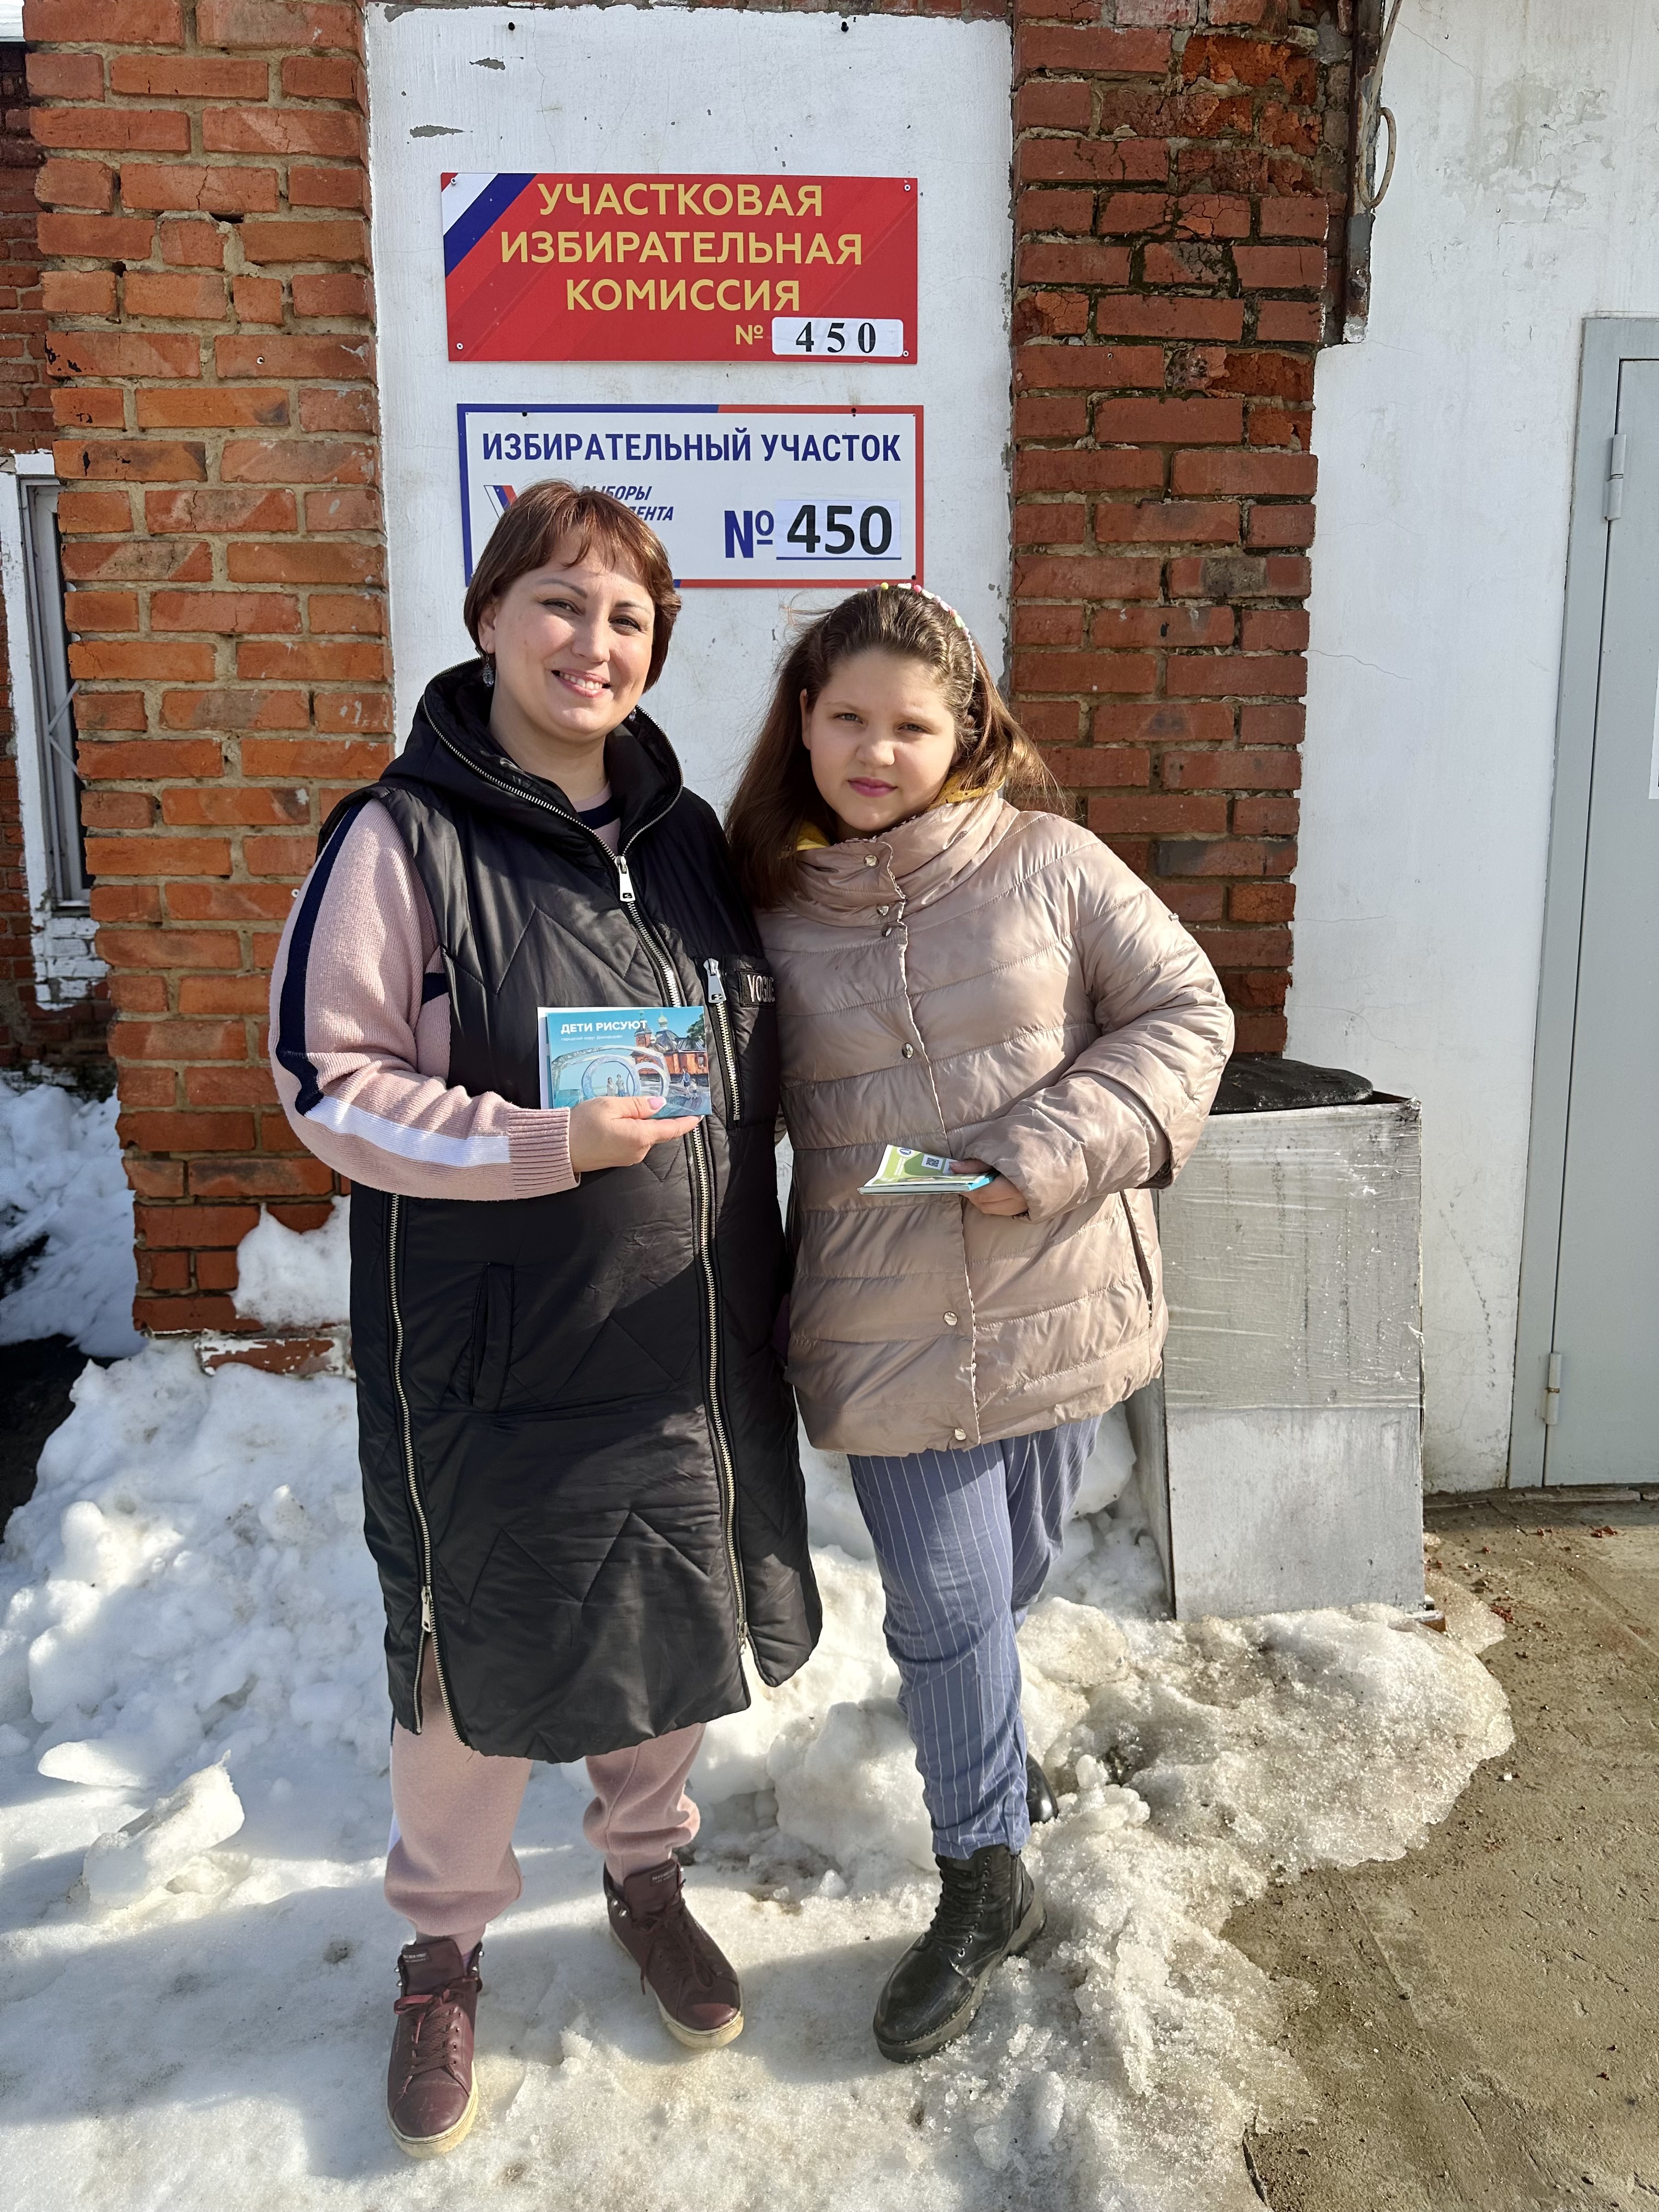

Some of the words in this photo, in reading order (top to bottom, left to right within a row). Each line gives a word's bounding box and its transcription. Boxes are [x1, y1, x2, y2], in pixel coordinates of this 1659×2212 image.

[538, 183, 822, 217] УЧАСТКОВАЯ
[501, 231, 862, 266] ИЗБИРАТЕЛЬНАЯ
[567, 279, 800, 312] КОМИССИЯ
[735, 324, 764, 345] №
[795, 321, 876, 354] 450
[483, 428, 751, 461] ИЗБИРАТЕЛЬНЫЙ
[761, 435, 901, 462] УЧАСТОК
[724, 510, 775, 558] №
[787, 505, 893, 556] 450
[561, 1023, 592, 1034] ДЕТИ
[596, 1020, 647, 1031] РИСУЮТ
